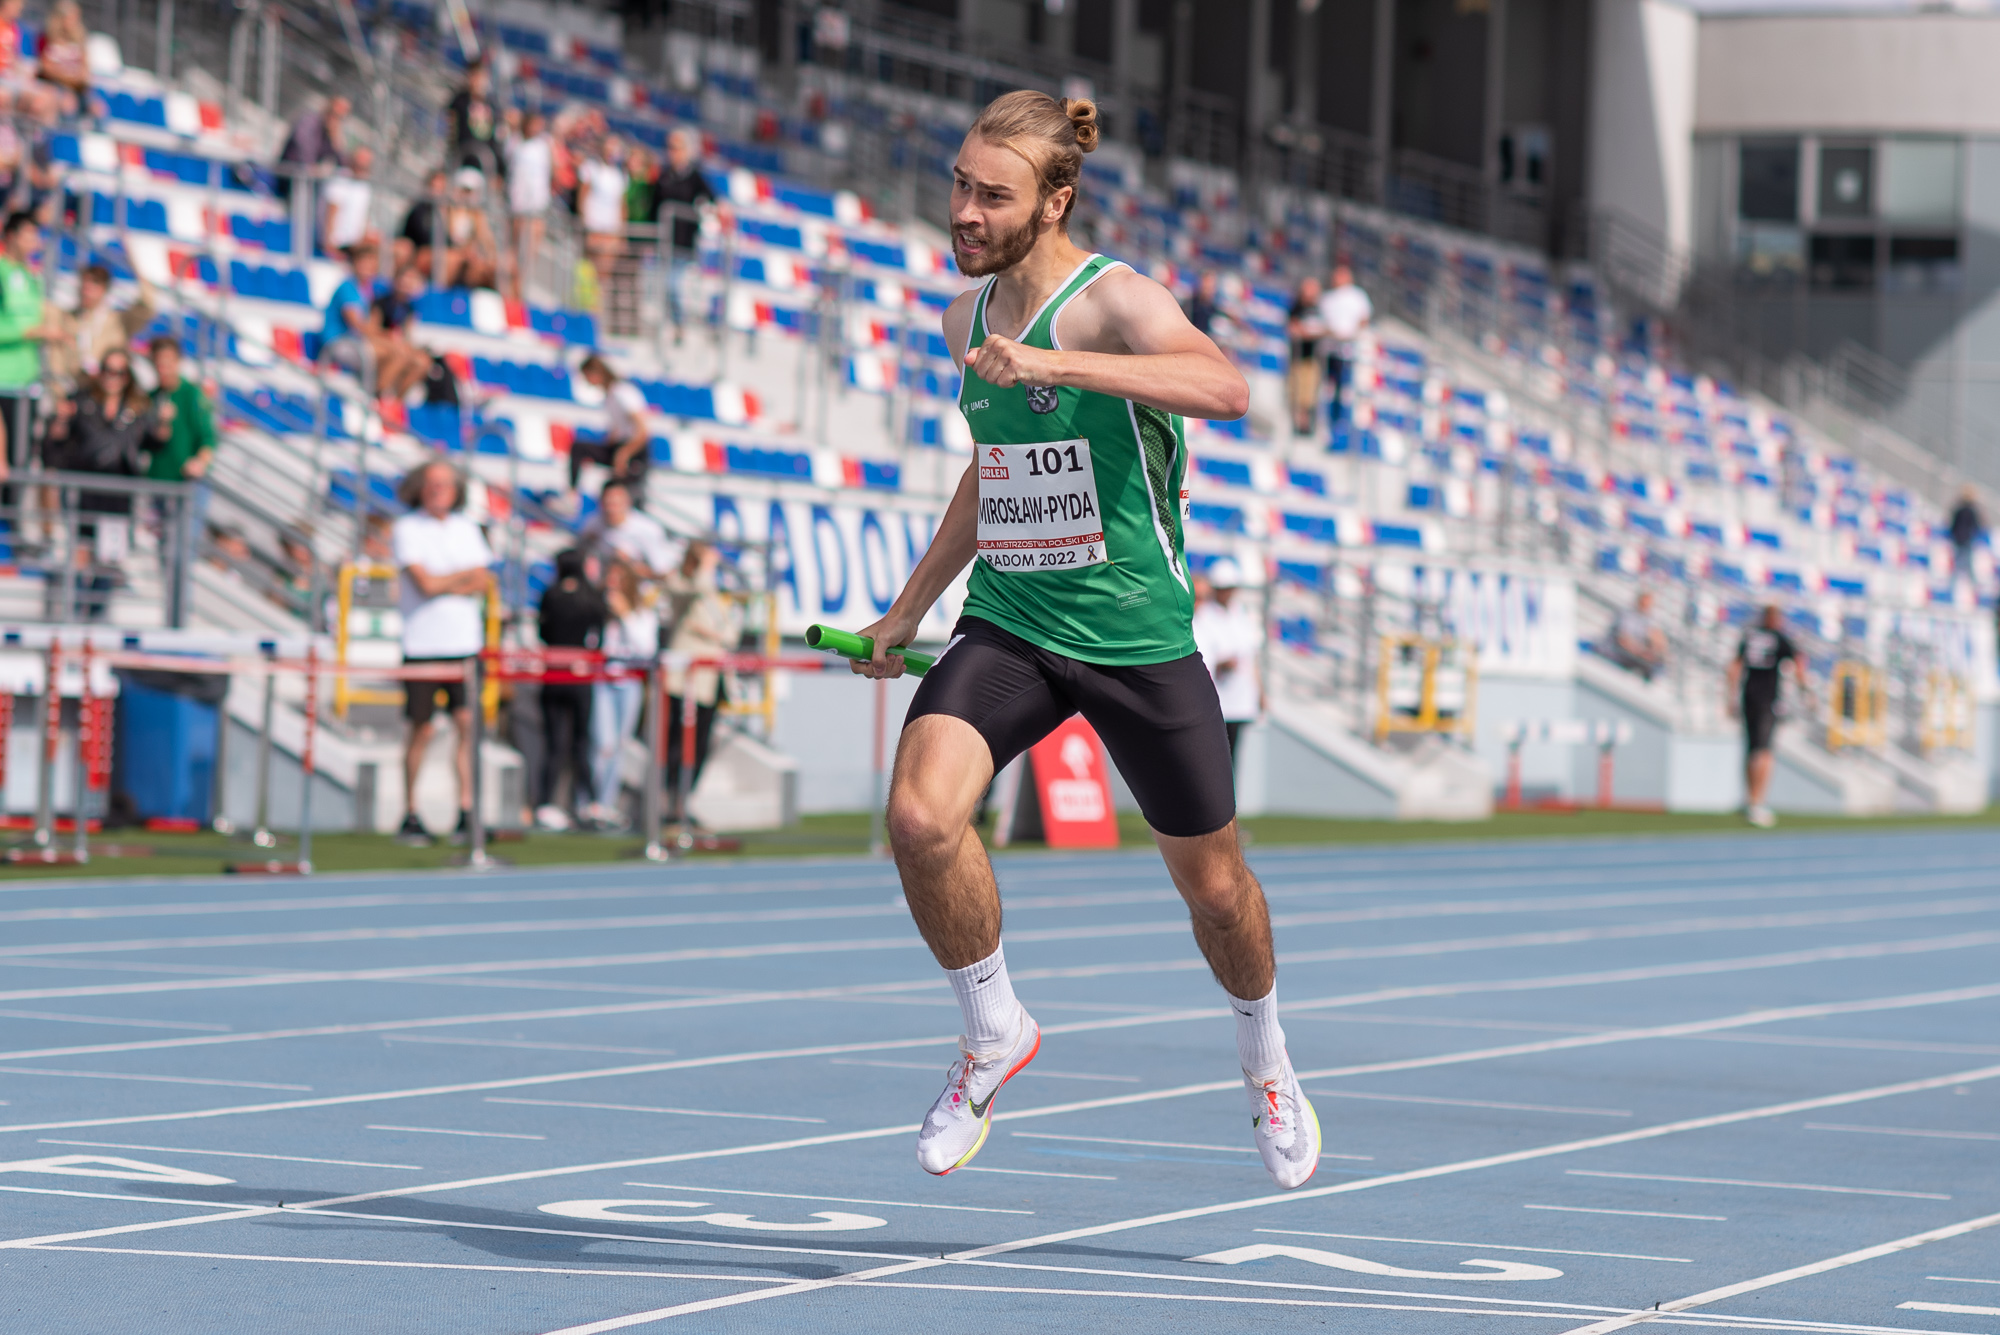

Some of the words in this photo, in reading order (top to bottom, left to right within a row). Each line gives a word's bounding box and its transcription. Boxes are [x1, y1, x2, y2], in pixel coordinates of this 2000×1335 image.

[970, 398, 990, 411] UMCS
[1025, 445, 1084, 476] 101
[981, 467, 1008, 478] ORLEN
[979, 491, 1096, 525] MIROSŁAW-PYDA
[996, 540, 1047, 548] MISTRZOSTWA
[1048, 537, 1080, 547] POLSKI
[1081, 533, 1101, 543] U20
[986, 553, 1035, 567] RADOM
[1039, 550, 1077, 566] 2022
